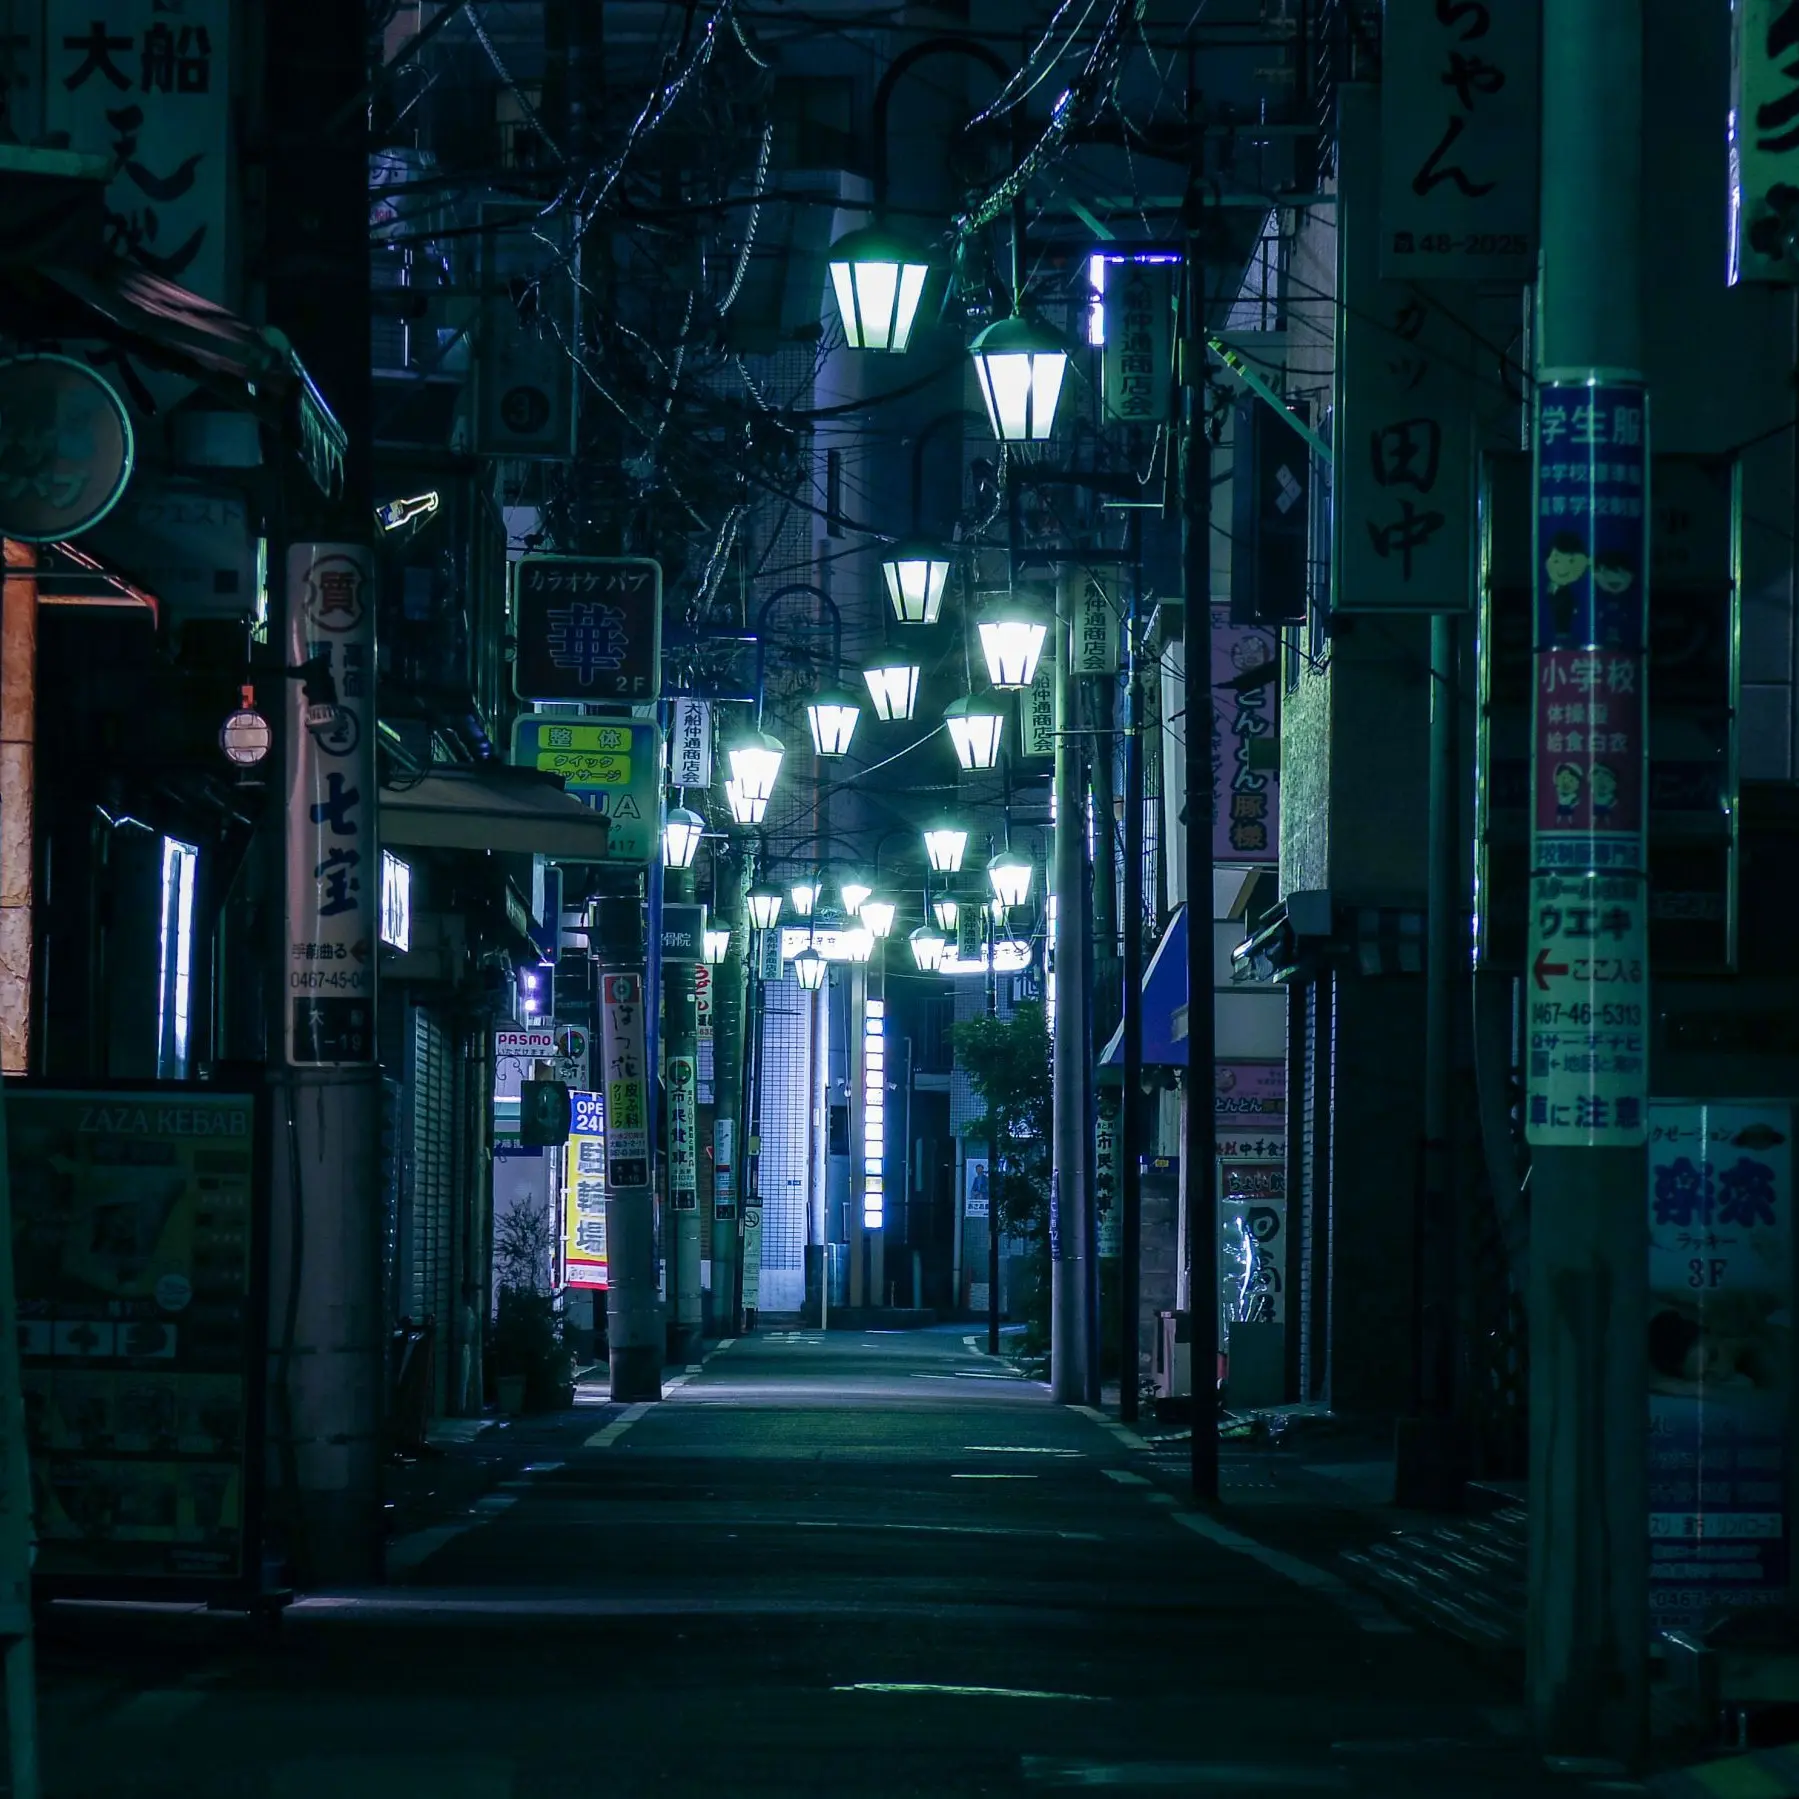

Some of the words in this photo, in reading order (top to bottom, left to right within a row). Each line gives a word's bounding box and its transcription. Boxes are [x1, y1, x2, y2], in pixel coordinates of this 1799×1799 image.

[62, 20, 213, 94] 大船
[1541, 405, 1642, 446] 学生服
[1365, 418, 1446, 583] 田中
[320, 571, 354, 618] 質
[527, 569, 601, 593] カラオケ
[1083, 567, 1107, 672] 大船仲通商店会
[615, 675, 646, 694] 2F
[1541, 657, 1636, 694] 小学校
[682, 702, 703, 784] 大船仲通商店会
[550, 769, 622, 783] ッサージ
[660, 931, 691, 947] 骨院
[1540, 906, 1632, 941] ウエキ
[291, 972, 366, 988] 0467-45-0
[498, 1034, 551, 1046] PASMO
[77, 1107, 148, 1134] ZAZA
[611, 1085, 623, 1128] クリニック
[1687, 1258, 1728, 1288] 3F
